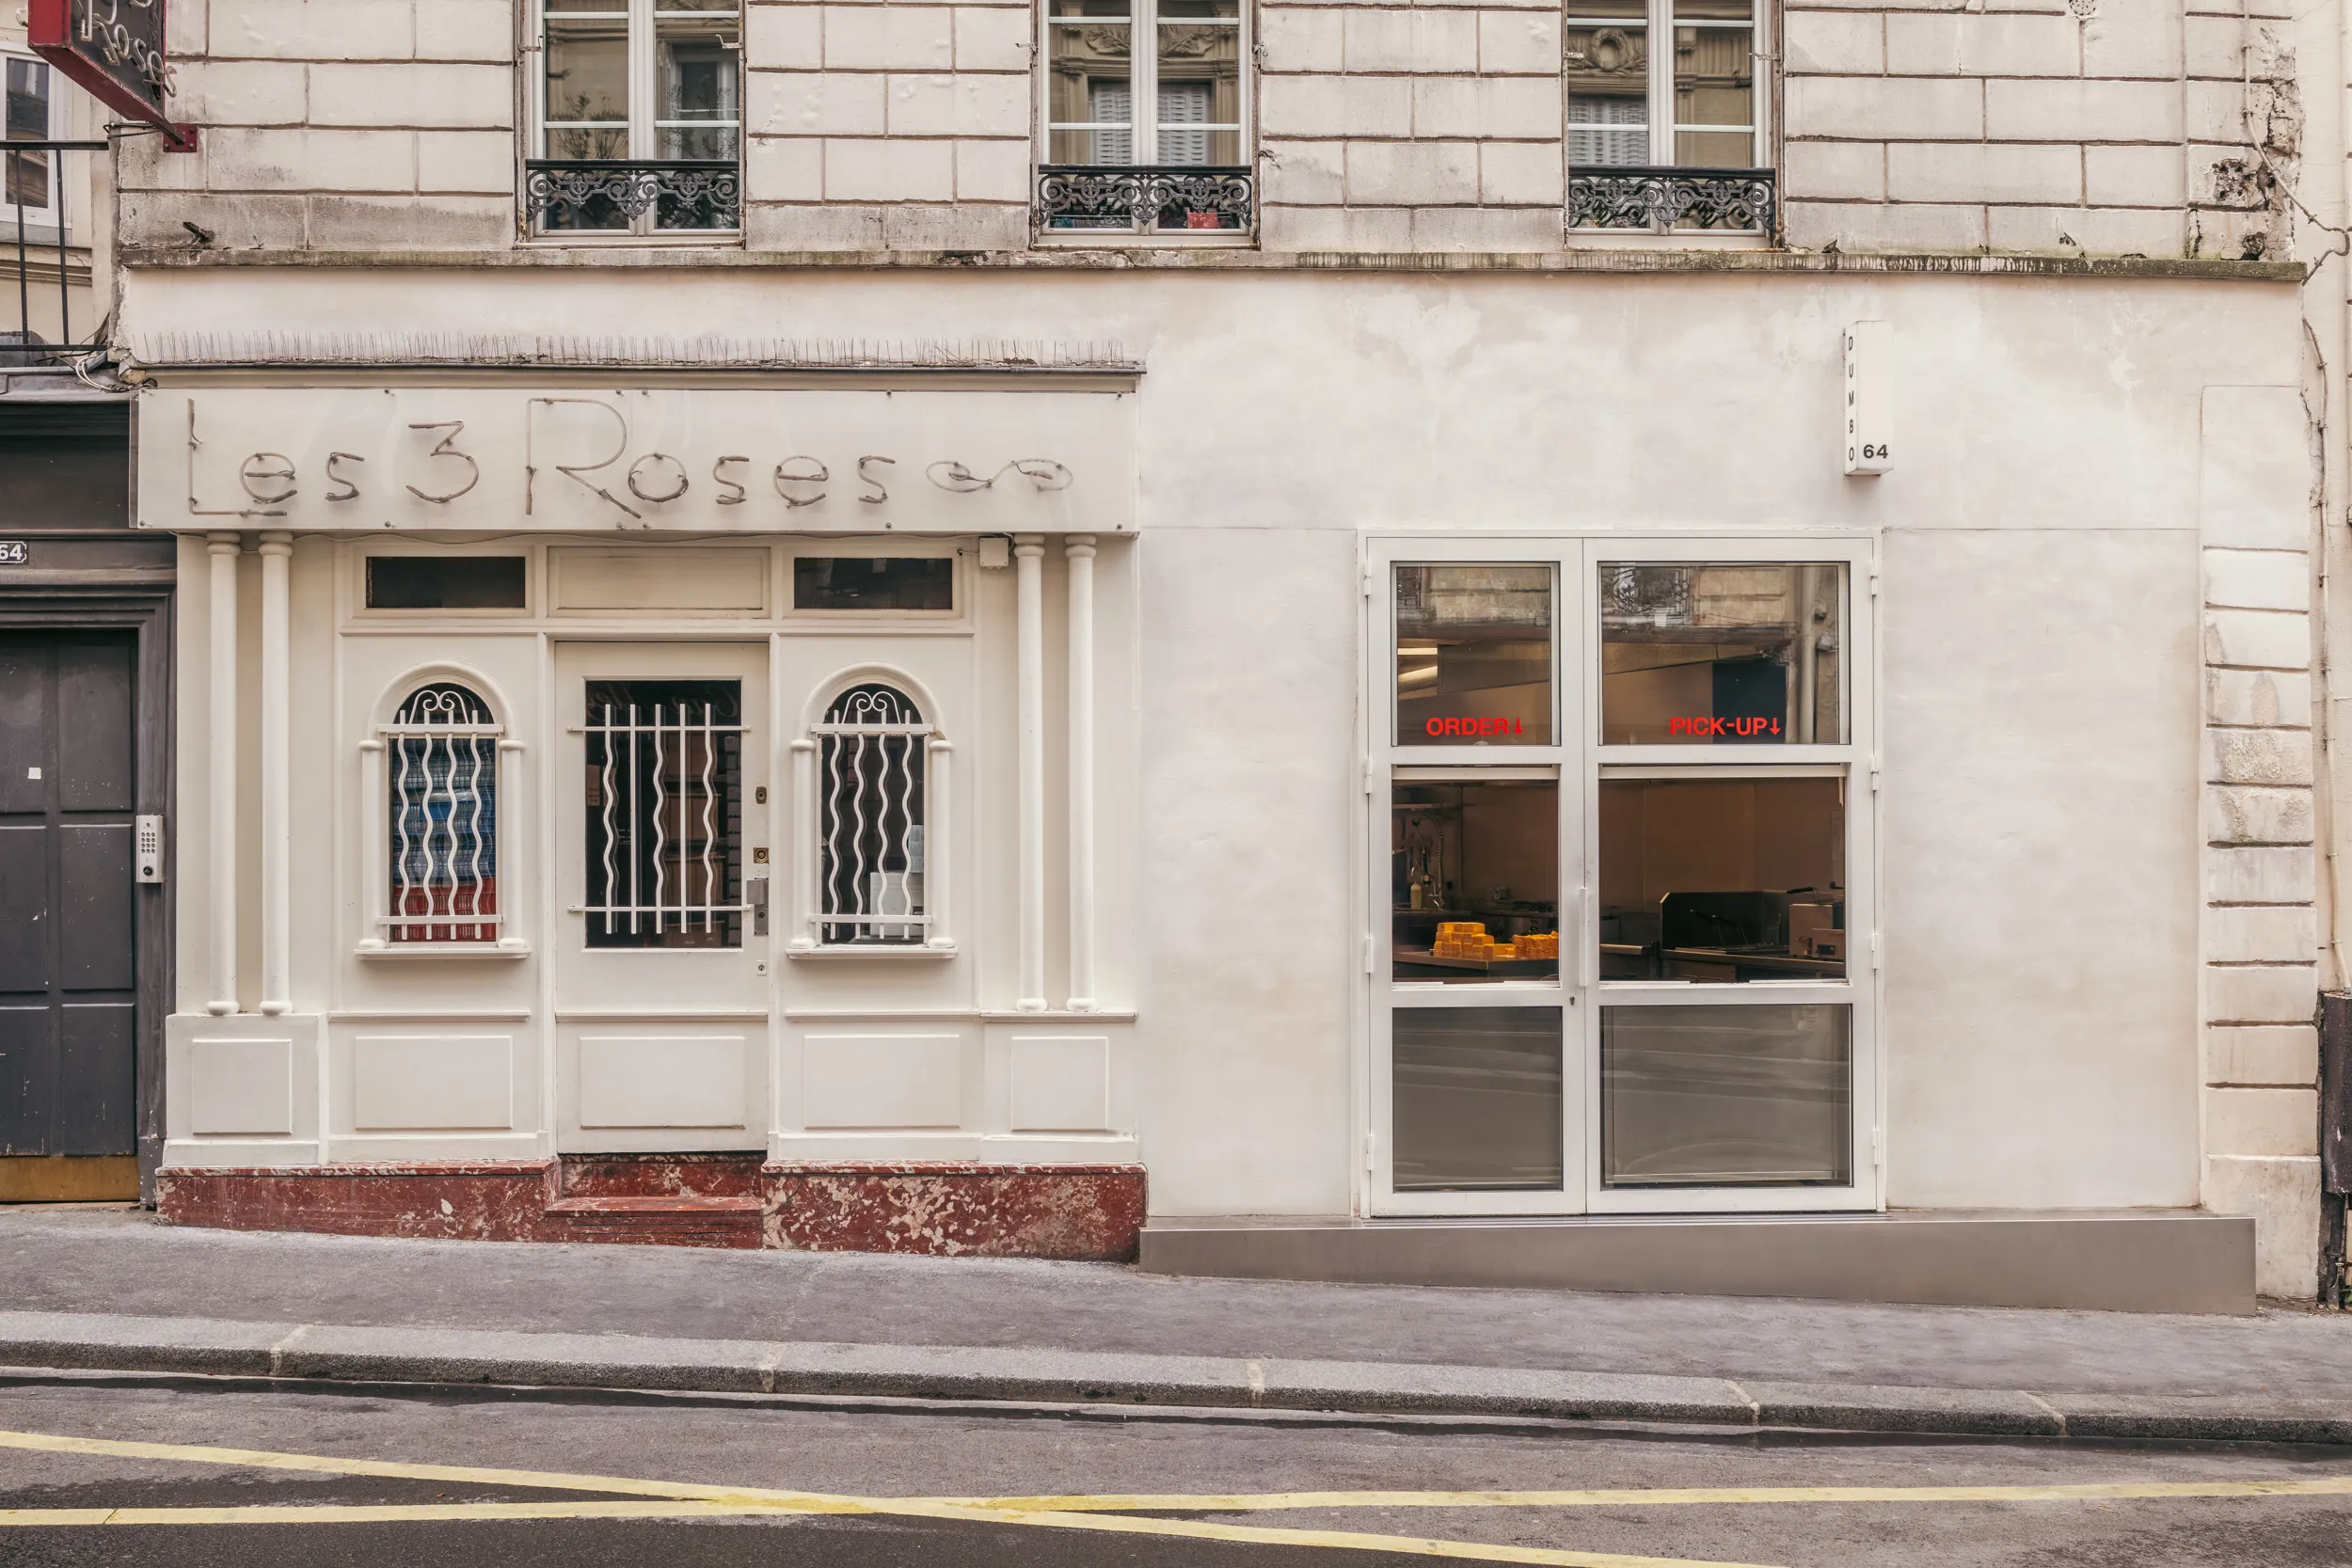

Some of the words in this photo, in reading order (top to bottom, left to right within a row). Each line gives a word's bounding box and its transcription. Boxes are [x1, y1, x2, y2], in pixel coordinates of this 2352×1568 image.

[187, 398, 365, 516] Les
[405, 420, 480, 504] 3
[525, 397, 896, 519] Roses
[1863, 444, 1888, 459] 64
[0, 544, 23, 561] 64
[1425, 717, 1509, 736] ORDER
[1670, 717, 1769, 736] PICK-UP
